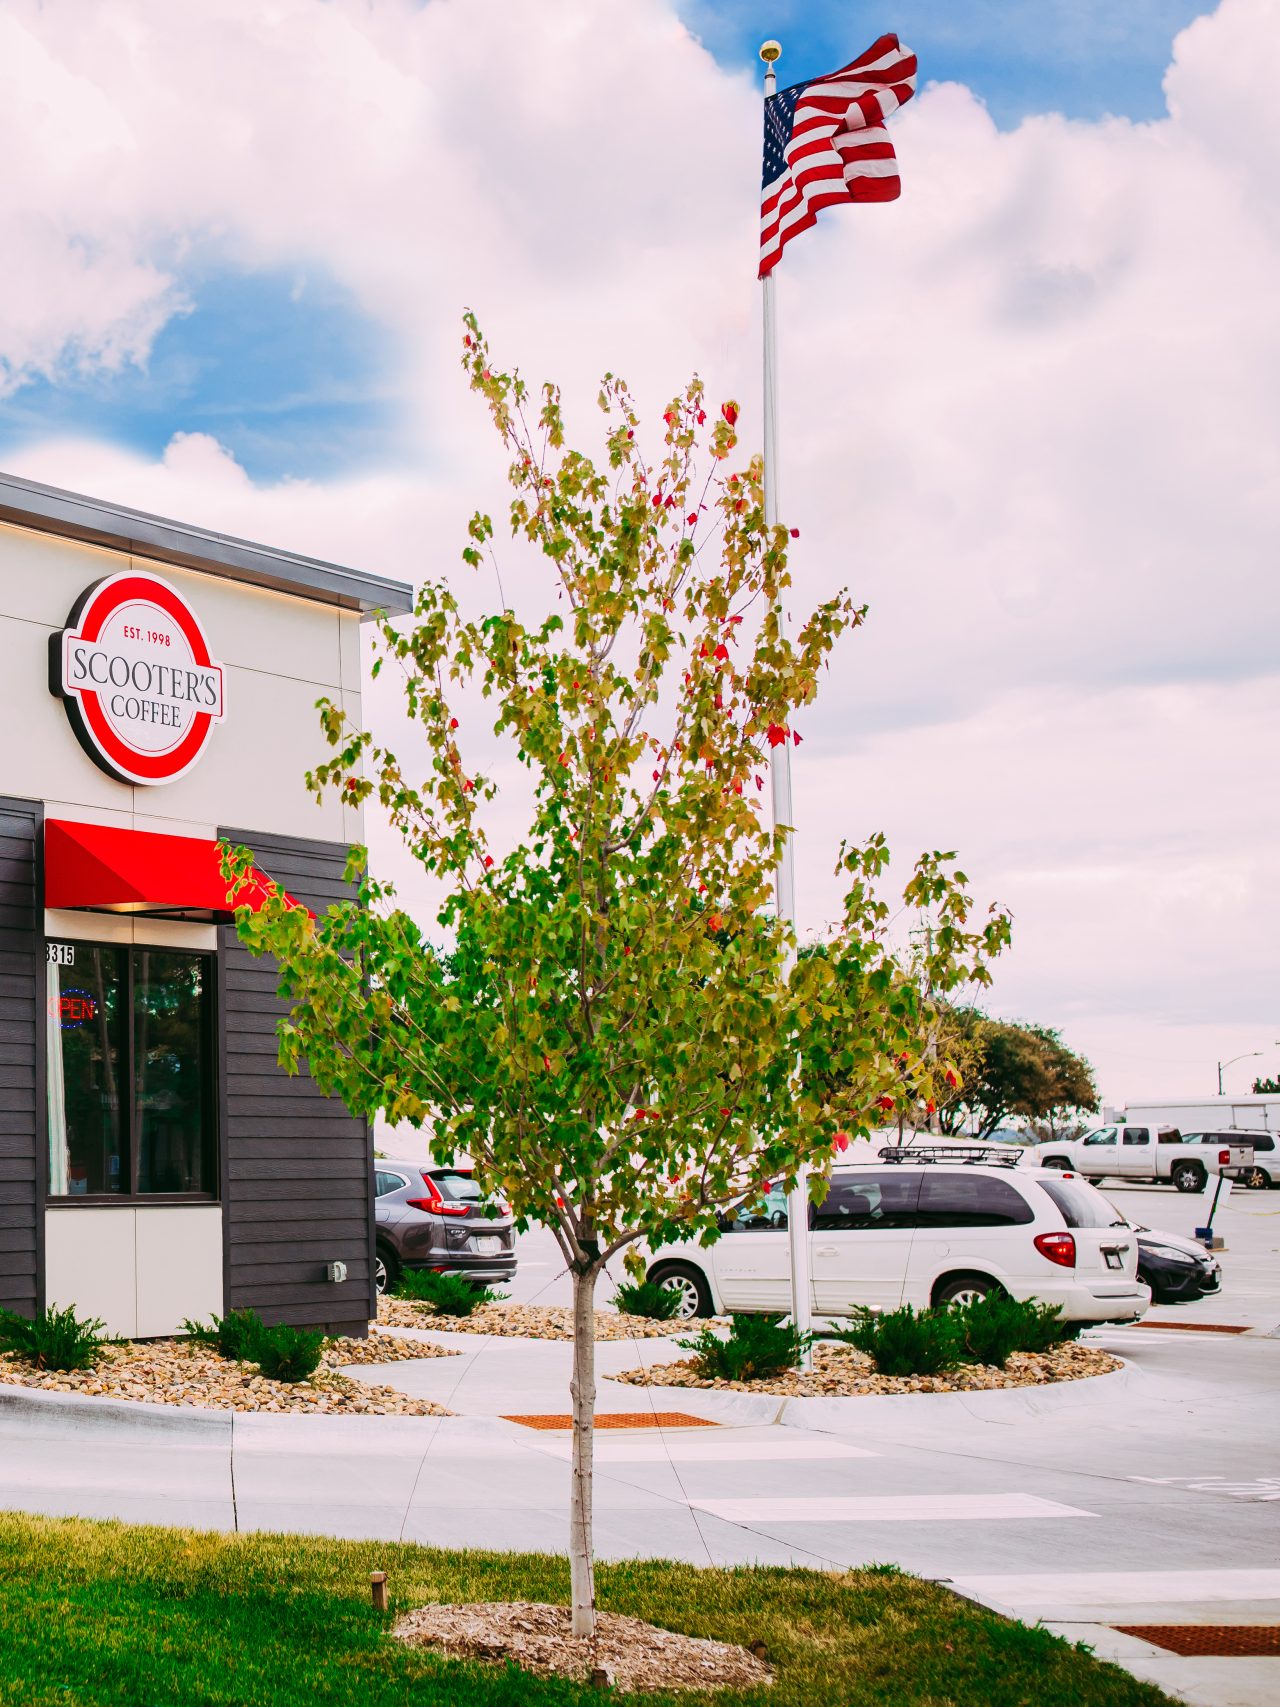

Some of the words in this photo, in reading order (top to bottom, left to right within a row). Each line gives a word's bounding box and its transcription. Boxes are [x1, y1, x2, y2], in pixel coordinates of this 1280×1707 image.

[123, 625, 144, 641] EST.
[147, 630, 171, 647] 1998
[73, 648, 217, 706] SCOOTER'S
[110, 694, 182, 728] COFFEE
[47, 996, 95, 1020] OPEN
